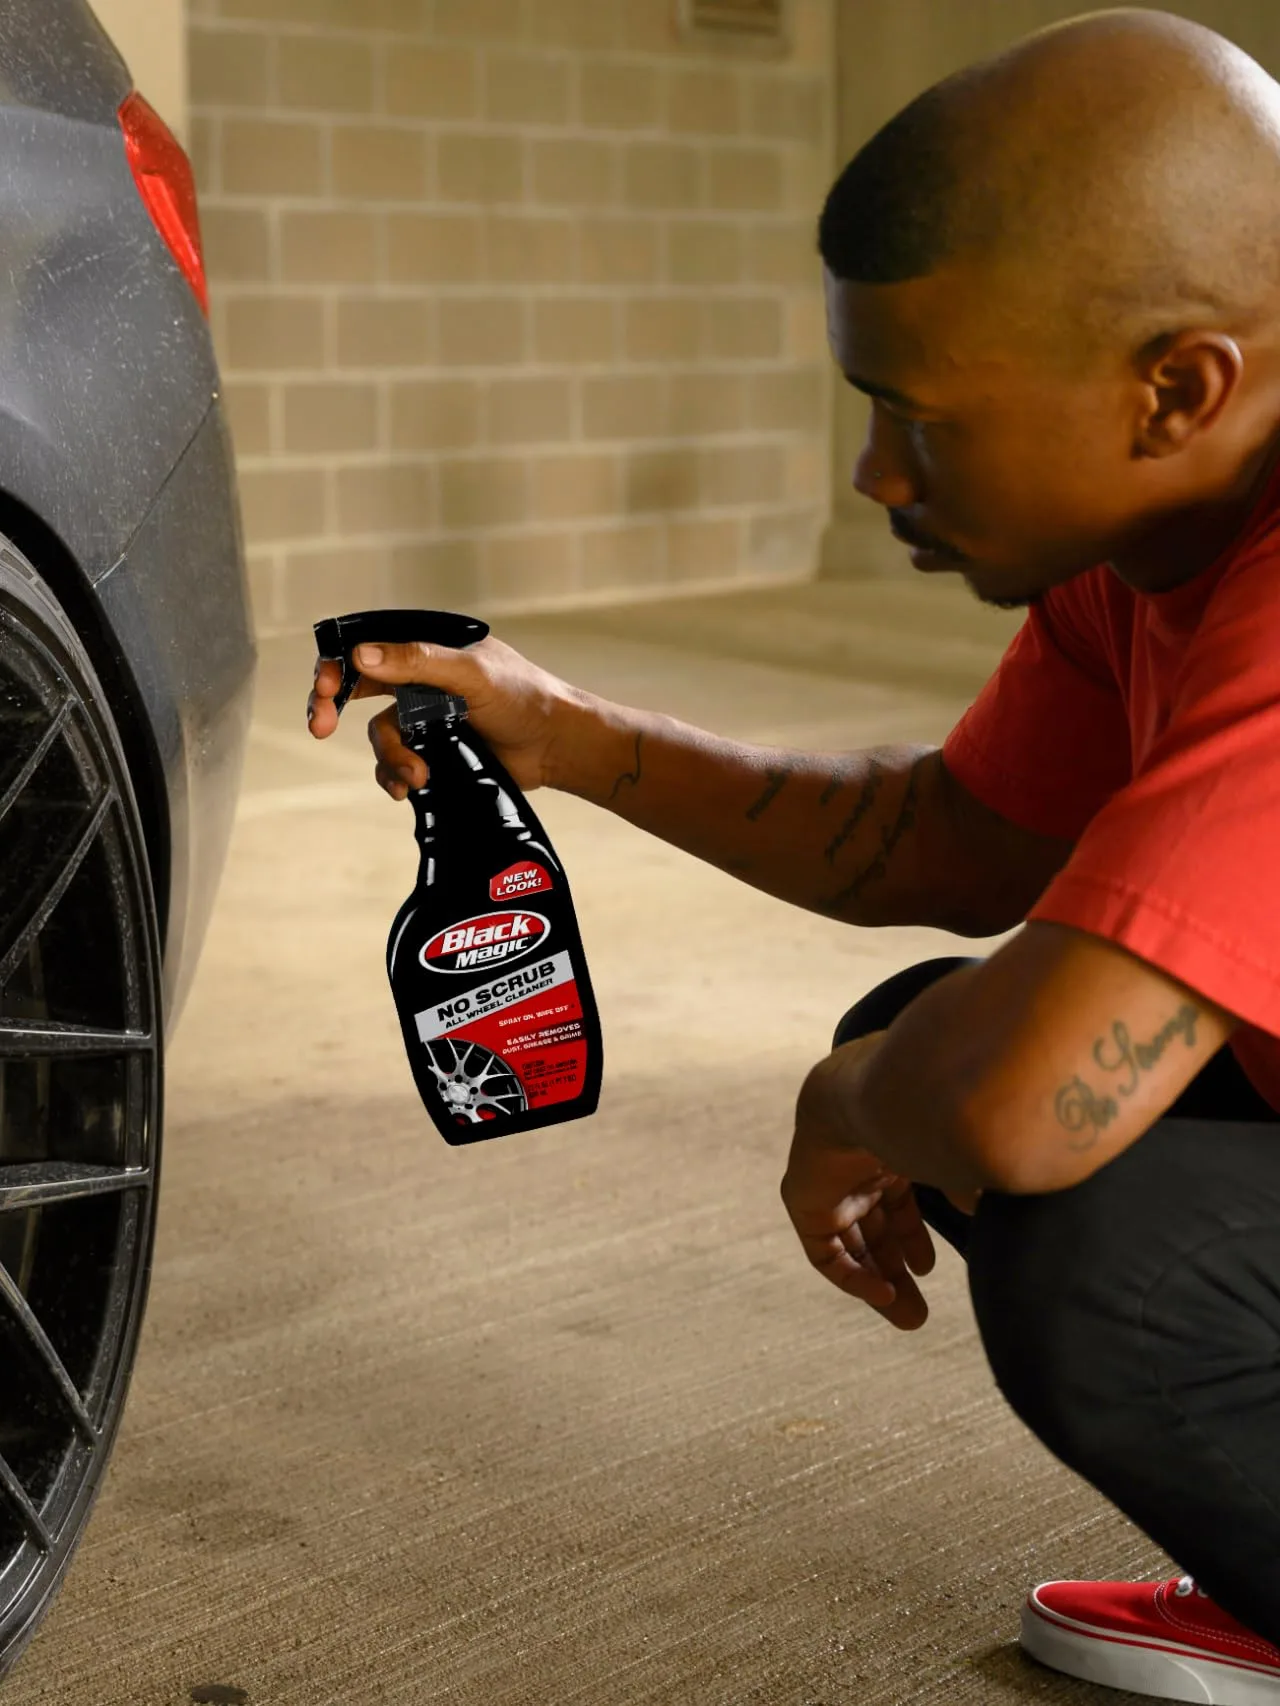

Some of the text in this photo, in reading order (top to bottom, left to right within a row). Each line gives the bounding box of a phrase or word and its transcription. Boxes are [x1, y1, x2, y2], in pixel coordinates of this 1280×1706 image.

[496, 878, 542, 896] LOOK!
[503, 869, 537, 885] NEW
[440, 914, 531, 954] Black
[455, 937, 529, 969] Magic
[437, 961, 556, 1022] NO SCRUB
[445, 978, 554, 1029] ALL WHEEL CLEANER
[498, 1016, 521, 1027] SPRAY
[536, 1008, 554, 1018] WIPE
[506, 1022, 581, 1046] EASILY REMOVES
[523, 1038, 552, 1050] GREASE
[559, 1030, 582, 1041] GRIME
